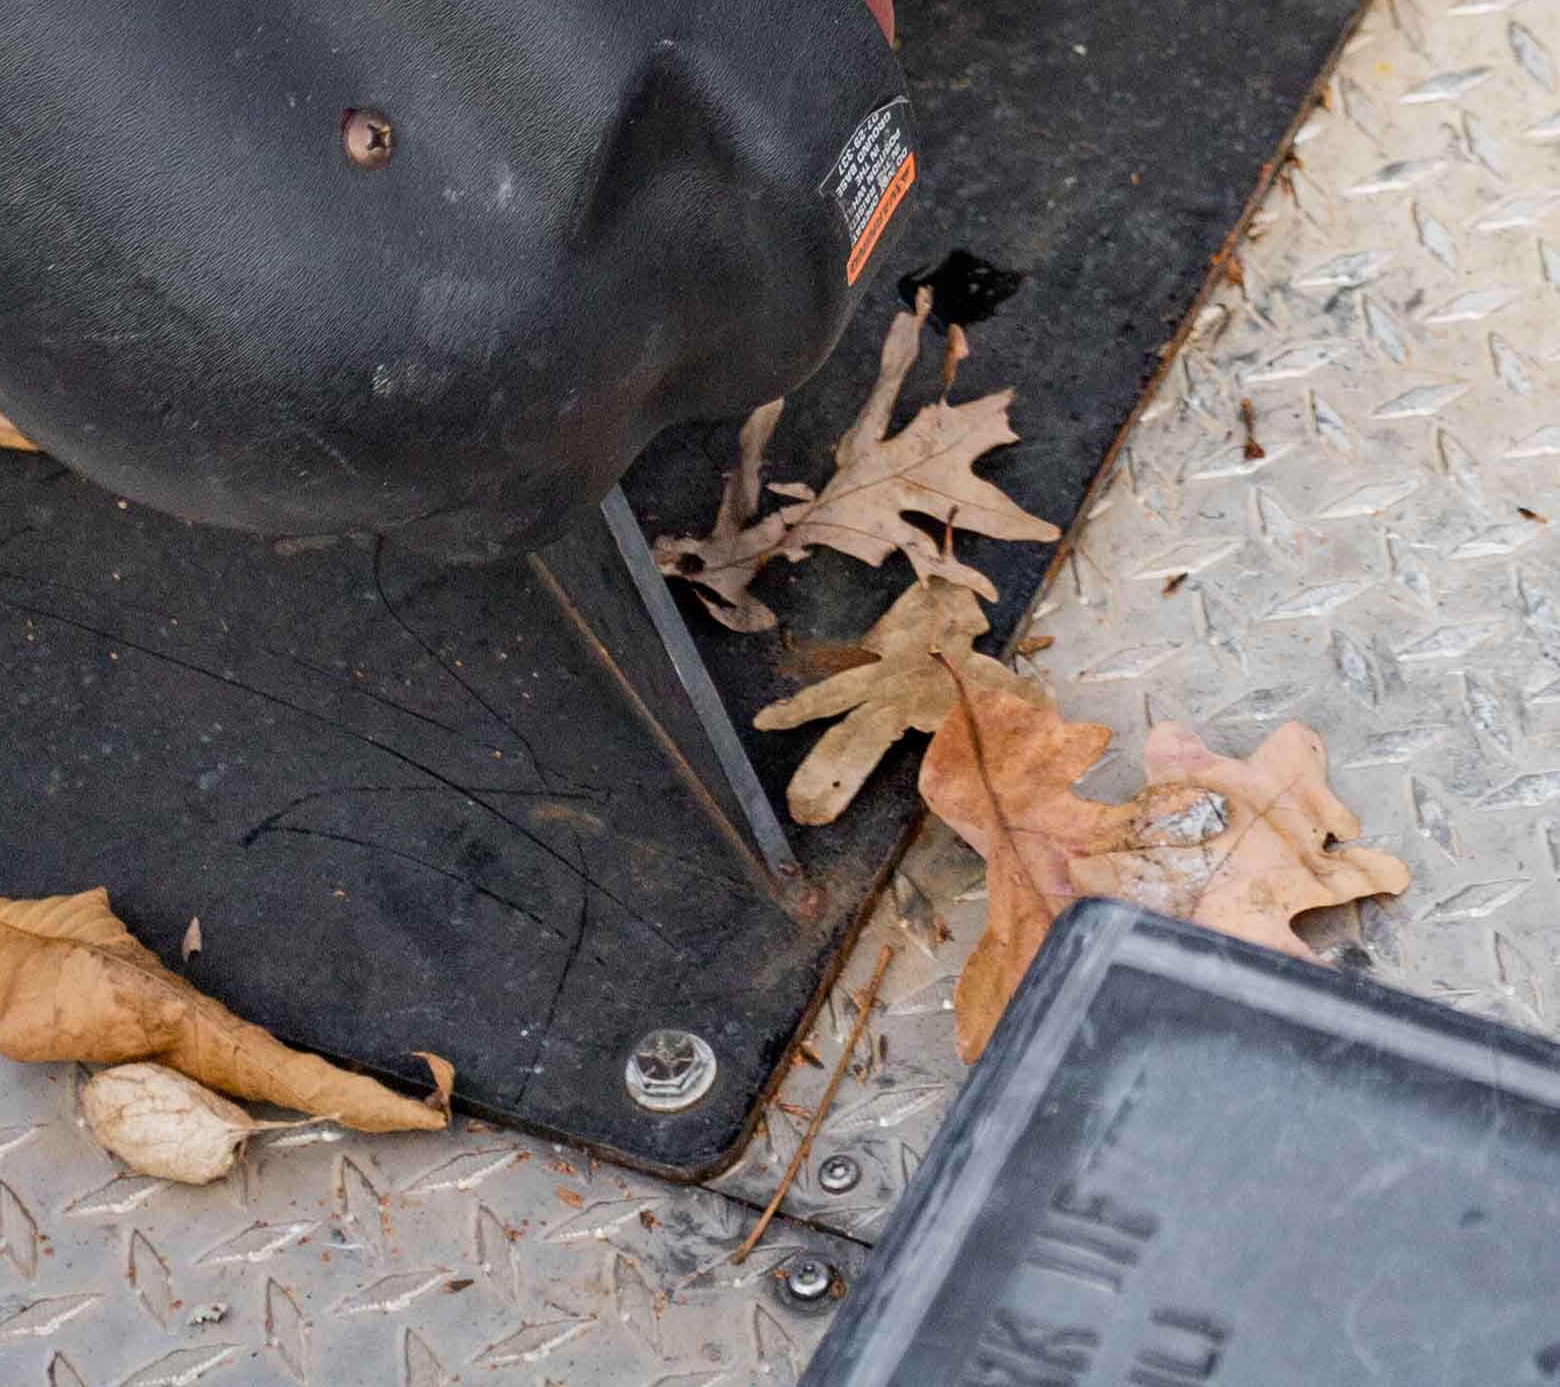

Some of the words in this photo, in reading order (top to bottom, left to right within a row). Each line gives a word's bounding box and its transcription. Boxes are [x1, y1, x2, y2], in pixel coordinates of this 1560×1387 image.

[839, 111, 879, 176] 07-29-337
[857, 111, 891, 162] GROUND
[866, 128, 901, 185] POSITION
[869, 143, 880, 162] IN
[835, 162, 858, 197] BASE
[854, 162, 870, 188] THE
